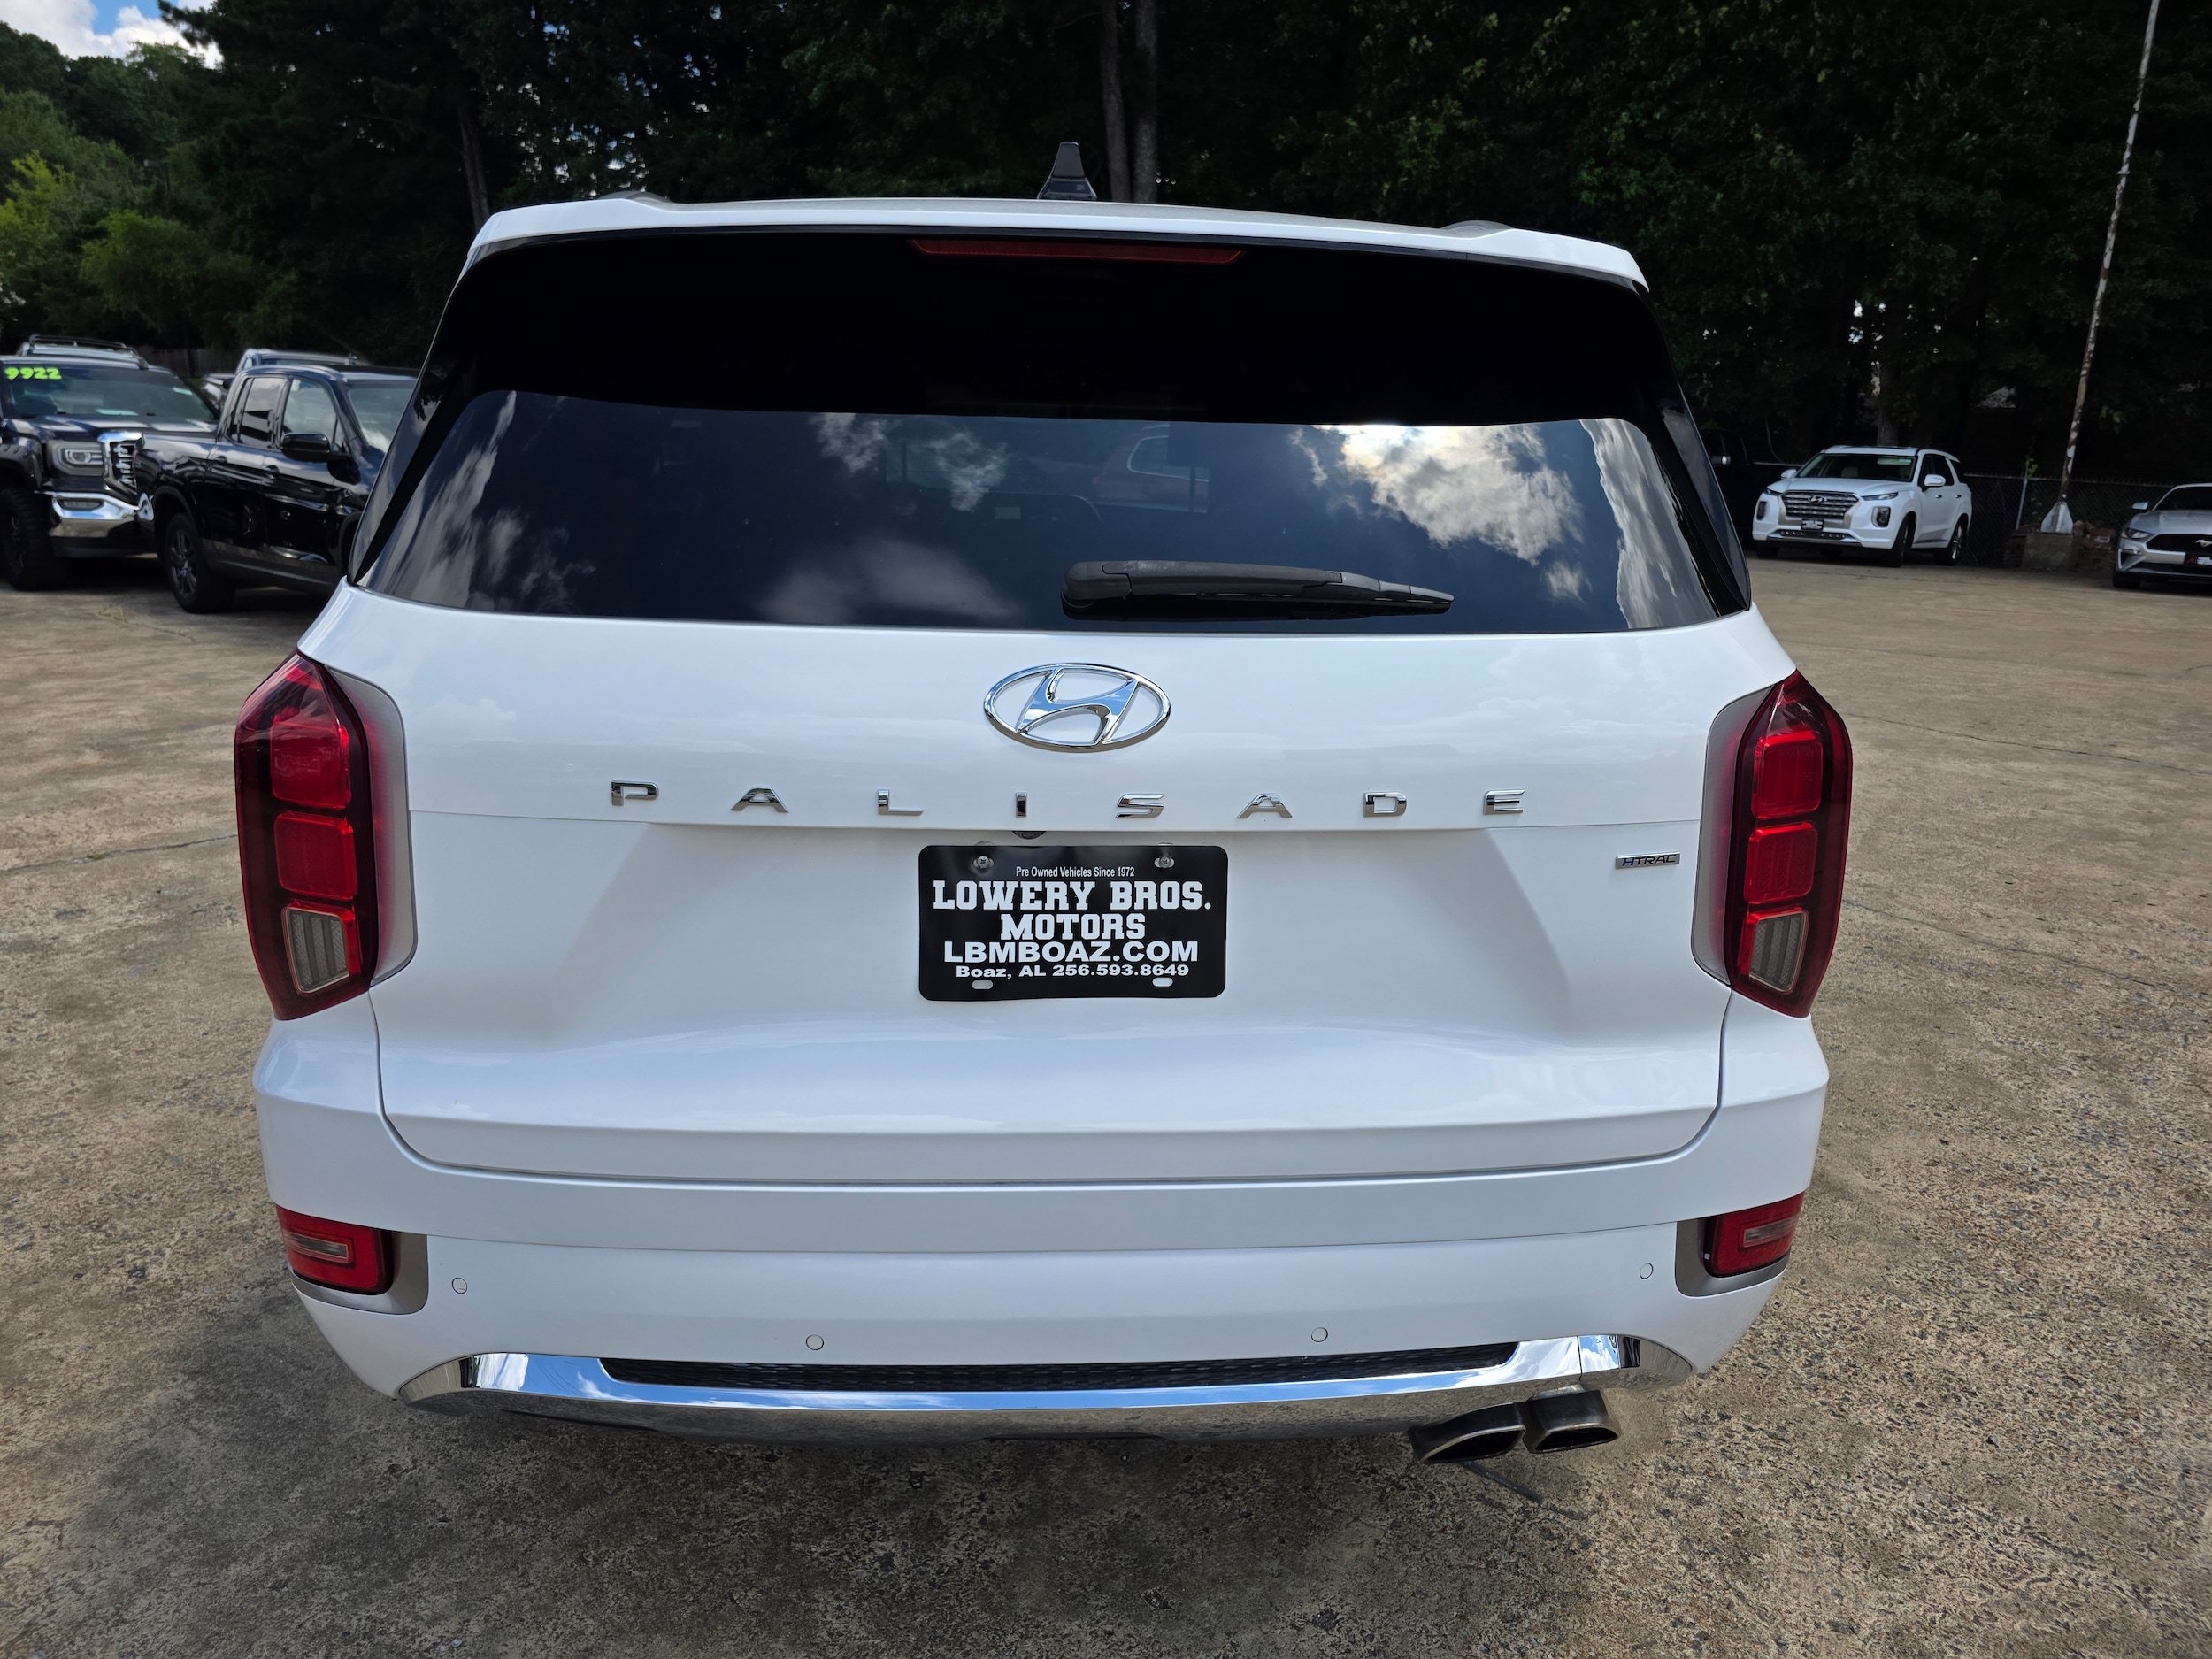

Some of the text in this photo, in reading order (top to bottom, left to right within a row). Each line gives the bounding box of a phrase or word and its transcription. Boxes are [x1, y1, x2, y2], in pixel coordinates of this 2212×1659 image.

[4, 366, 62, 380] 9922
[611, 780, 1526, 819] PALISADE
[1622, 853, 1678, 866] HTRAC
[1016, 865, 1135, 878] Pre Owned Vehicles Since 1972
[933, 880, 1212, 910] LOWERY BROS.
[1000, 913, 1146, 941] MOTORS
[944, 941, 1198, 963] LBMBOAZ.COM
[956, 964, 1190, 979] Boaz, AL 256.593.8649
